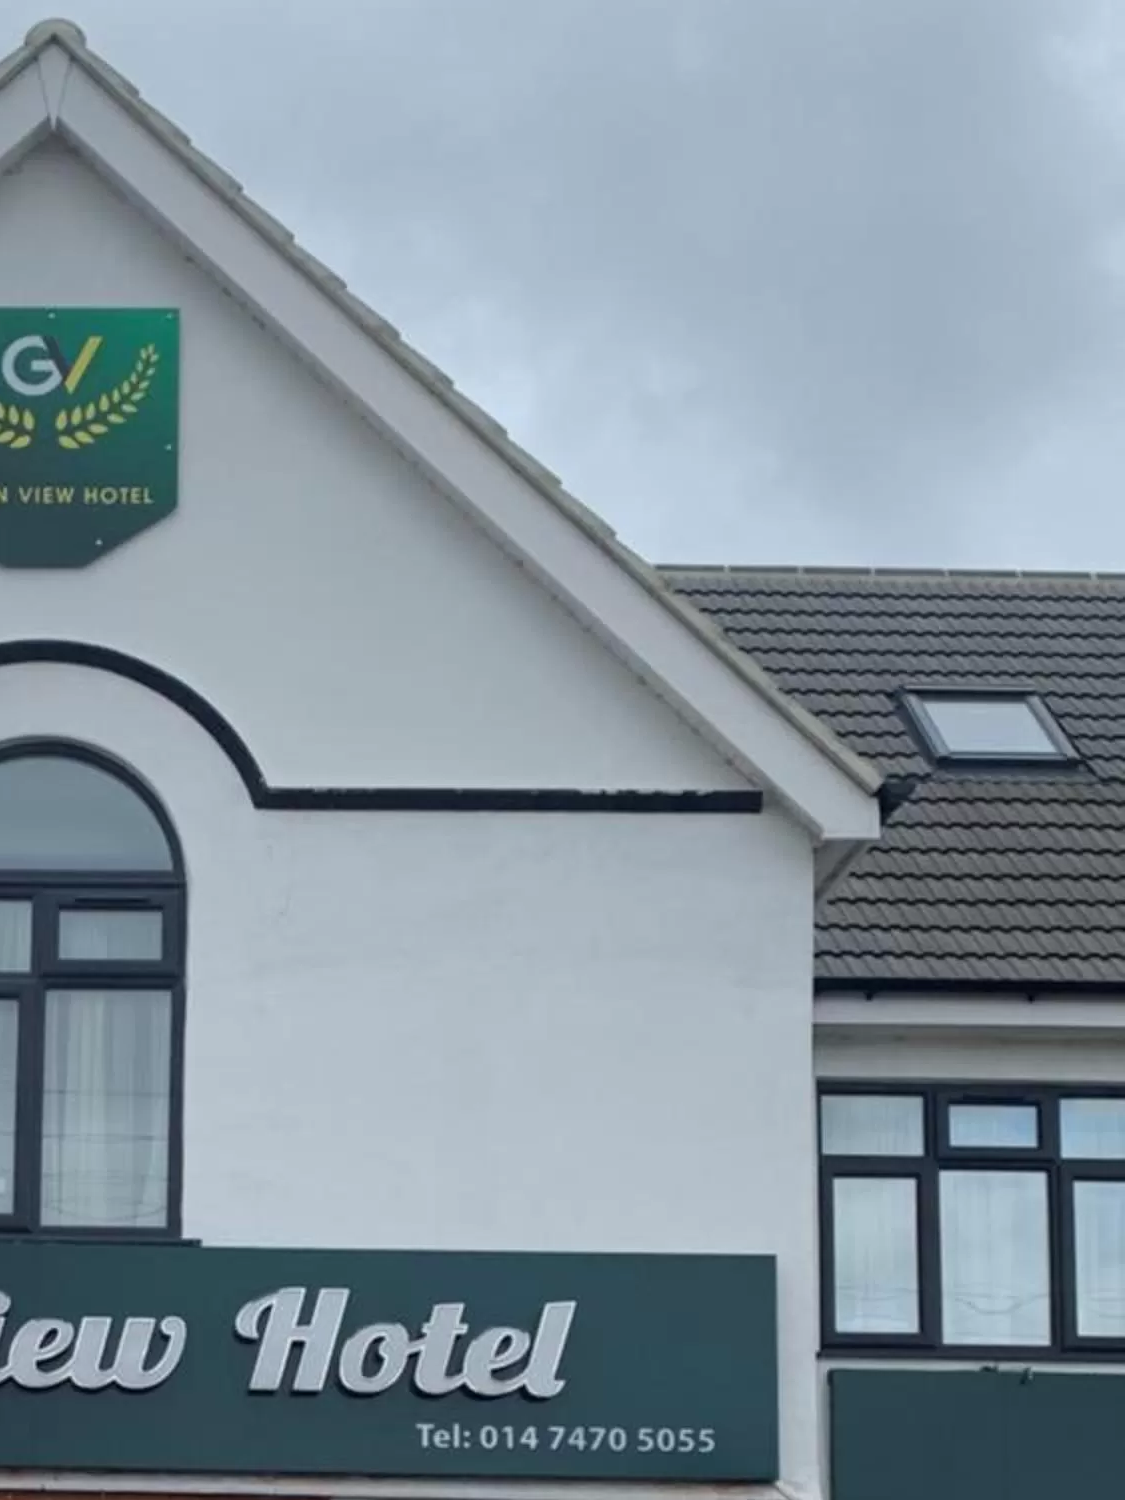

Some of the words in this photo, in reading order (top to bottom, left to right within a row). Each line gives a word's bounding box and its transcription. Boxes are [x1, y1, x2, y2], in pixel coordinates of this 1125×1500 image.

[1, 335, 104, 396] GV
[19, 487, 75, 504] VIEW
[83, 487, 155, 505] HOTEL
[234, 1287, 579, 1399] Hotel
[416, 1423, 471, 1449] Tel:
[480, 1426, 538, 1450] 014
[549, 1427, 627, 1451] 7470
[637, 1428, 716, 1453] 5055
